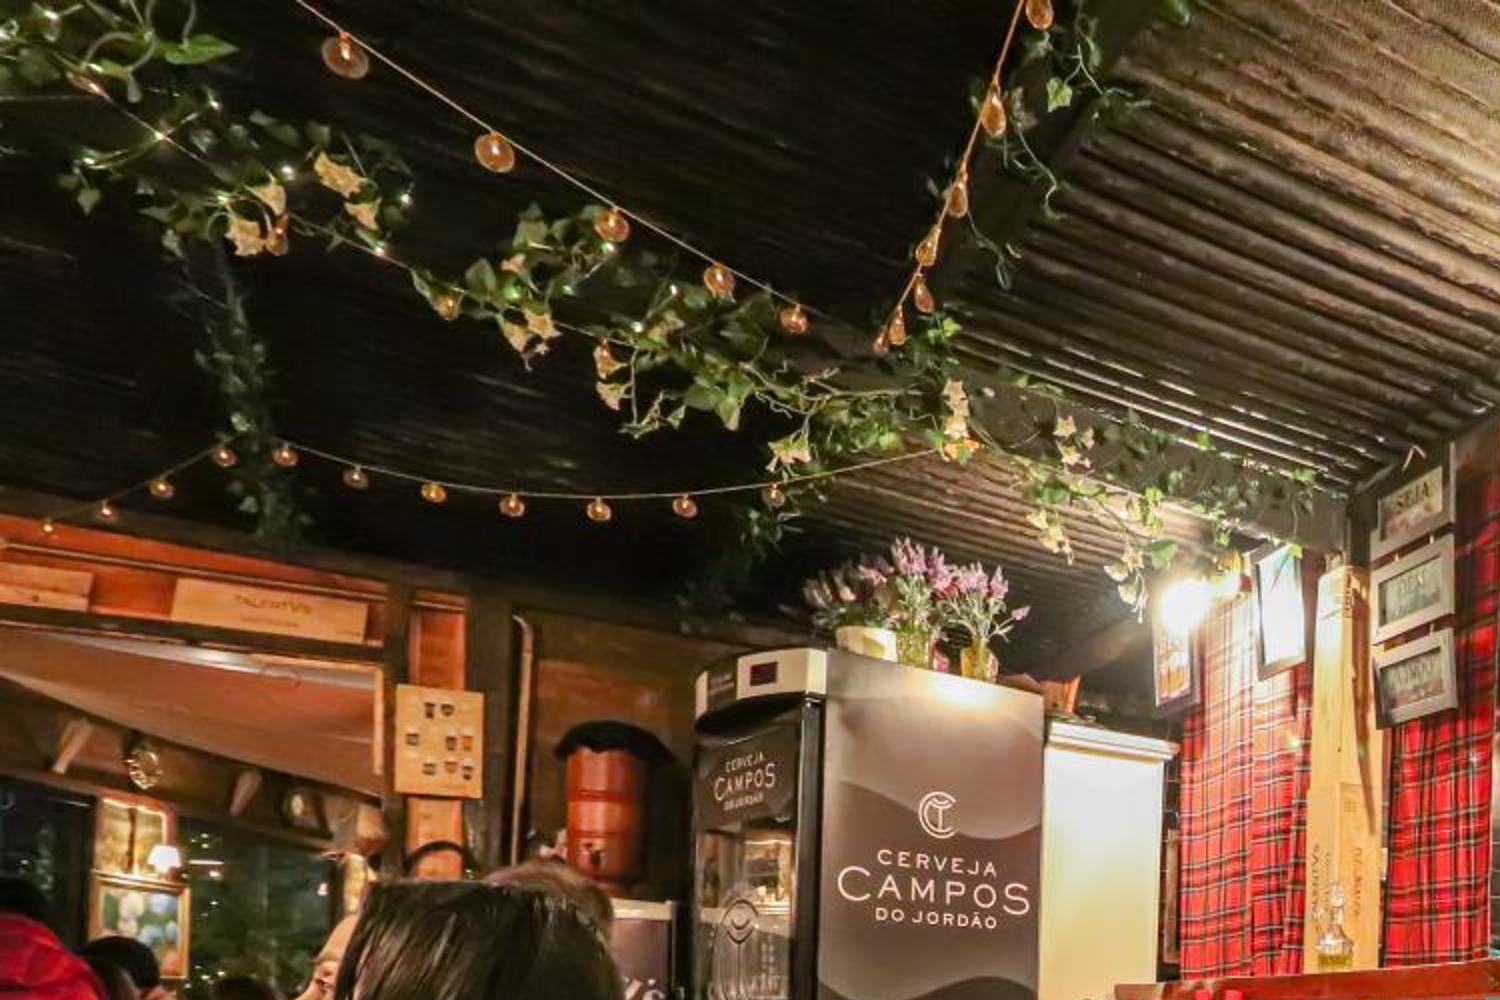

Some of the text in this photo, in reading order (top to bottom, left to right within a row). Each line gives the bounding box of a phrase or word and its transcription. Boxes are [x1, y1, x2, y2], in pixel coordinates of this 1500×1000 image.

[713, 763, 776, 801] CAMPOS
[877, 849, 997, 878] CERVEJA
[837, 865, 1030, 915] CAMPOS
[875, 907, 998, 929] DO JORDÃO
